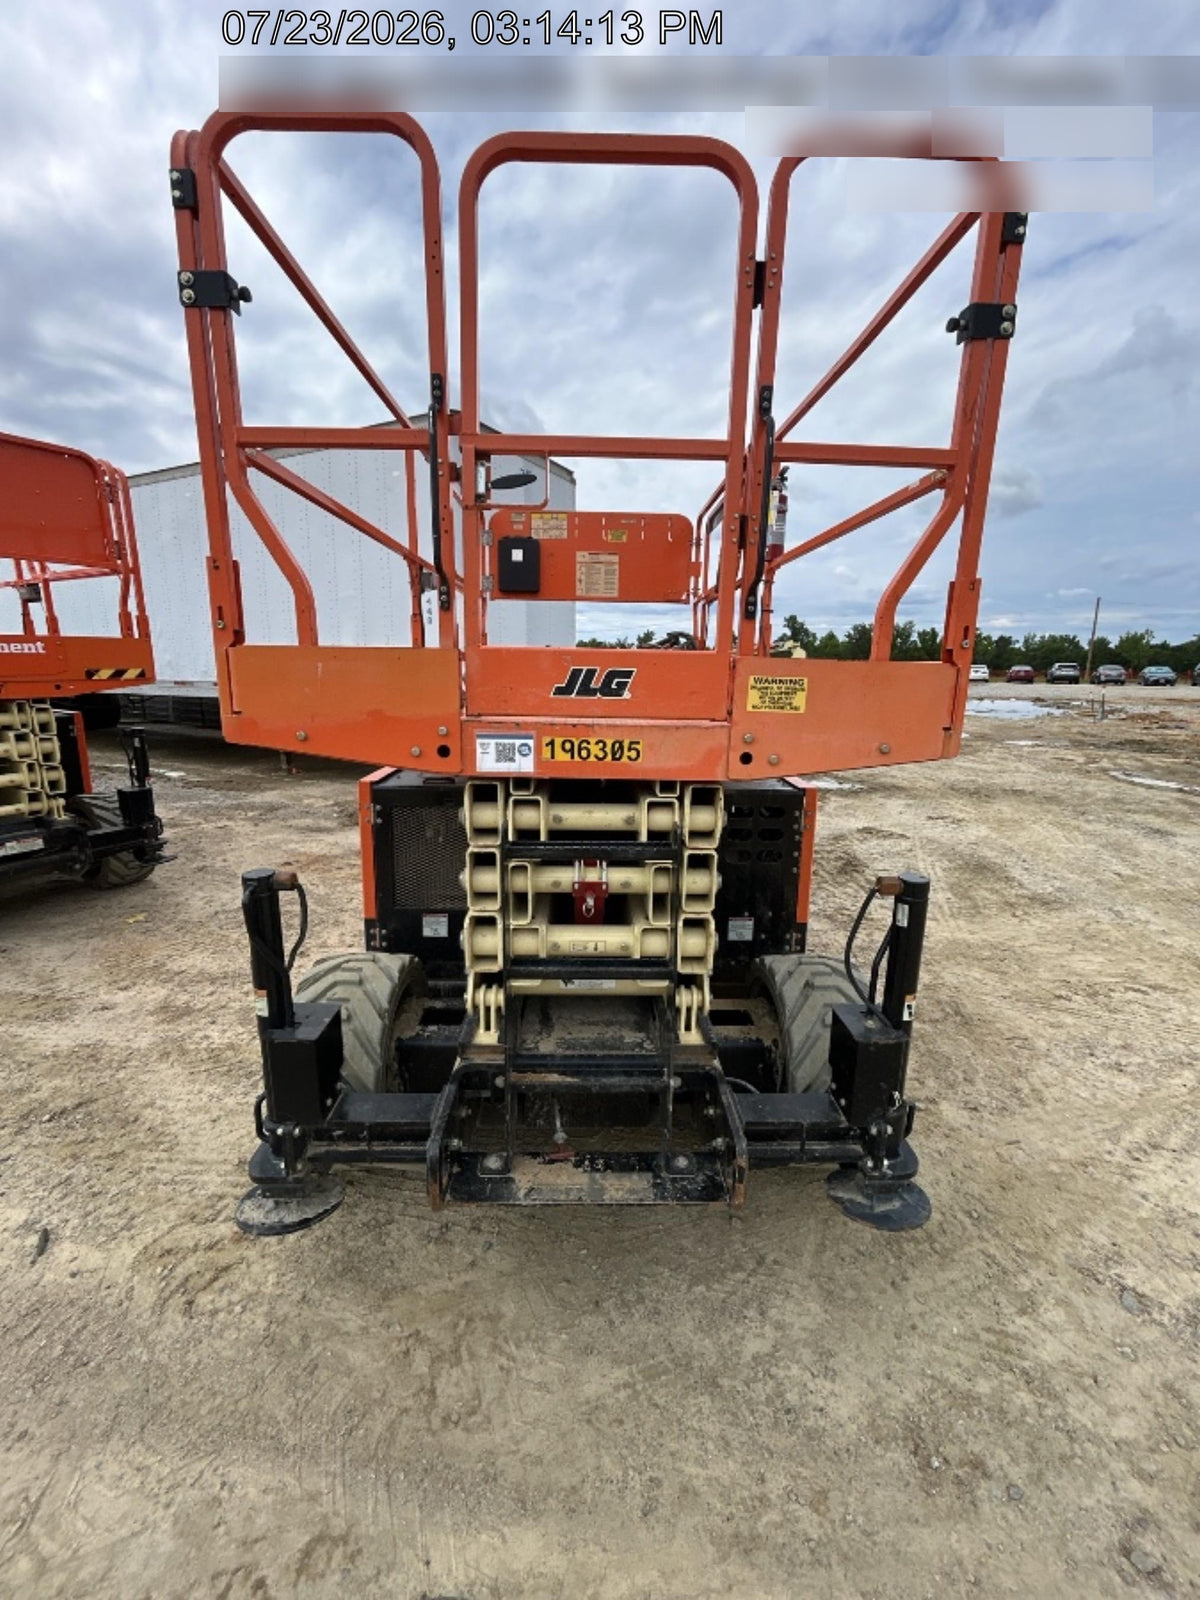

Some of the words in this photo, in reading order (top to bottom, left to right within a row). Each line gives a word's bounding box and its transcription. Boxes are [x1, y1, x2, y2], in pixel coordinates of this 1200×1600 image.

[550, 666, 637, 699] JLG
[753, 676, 805, 687] WARNING
[545, 738, 642, 762] 196305
